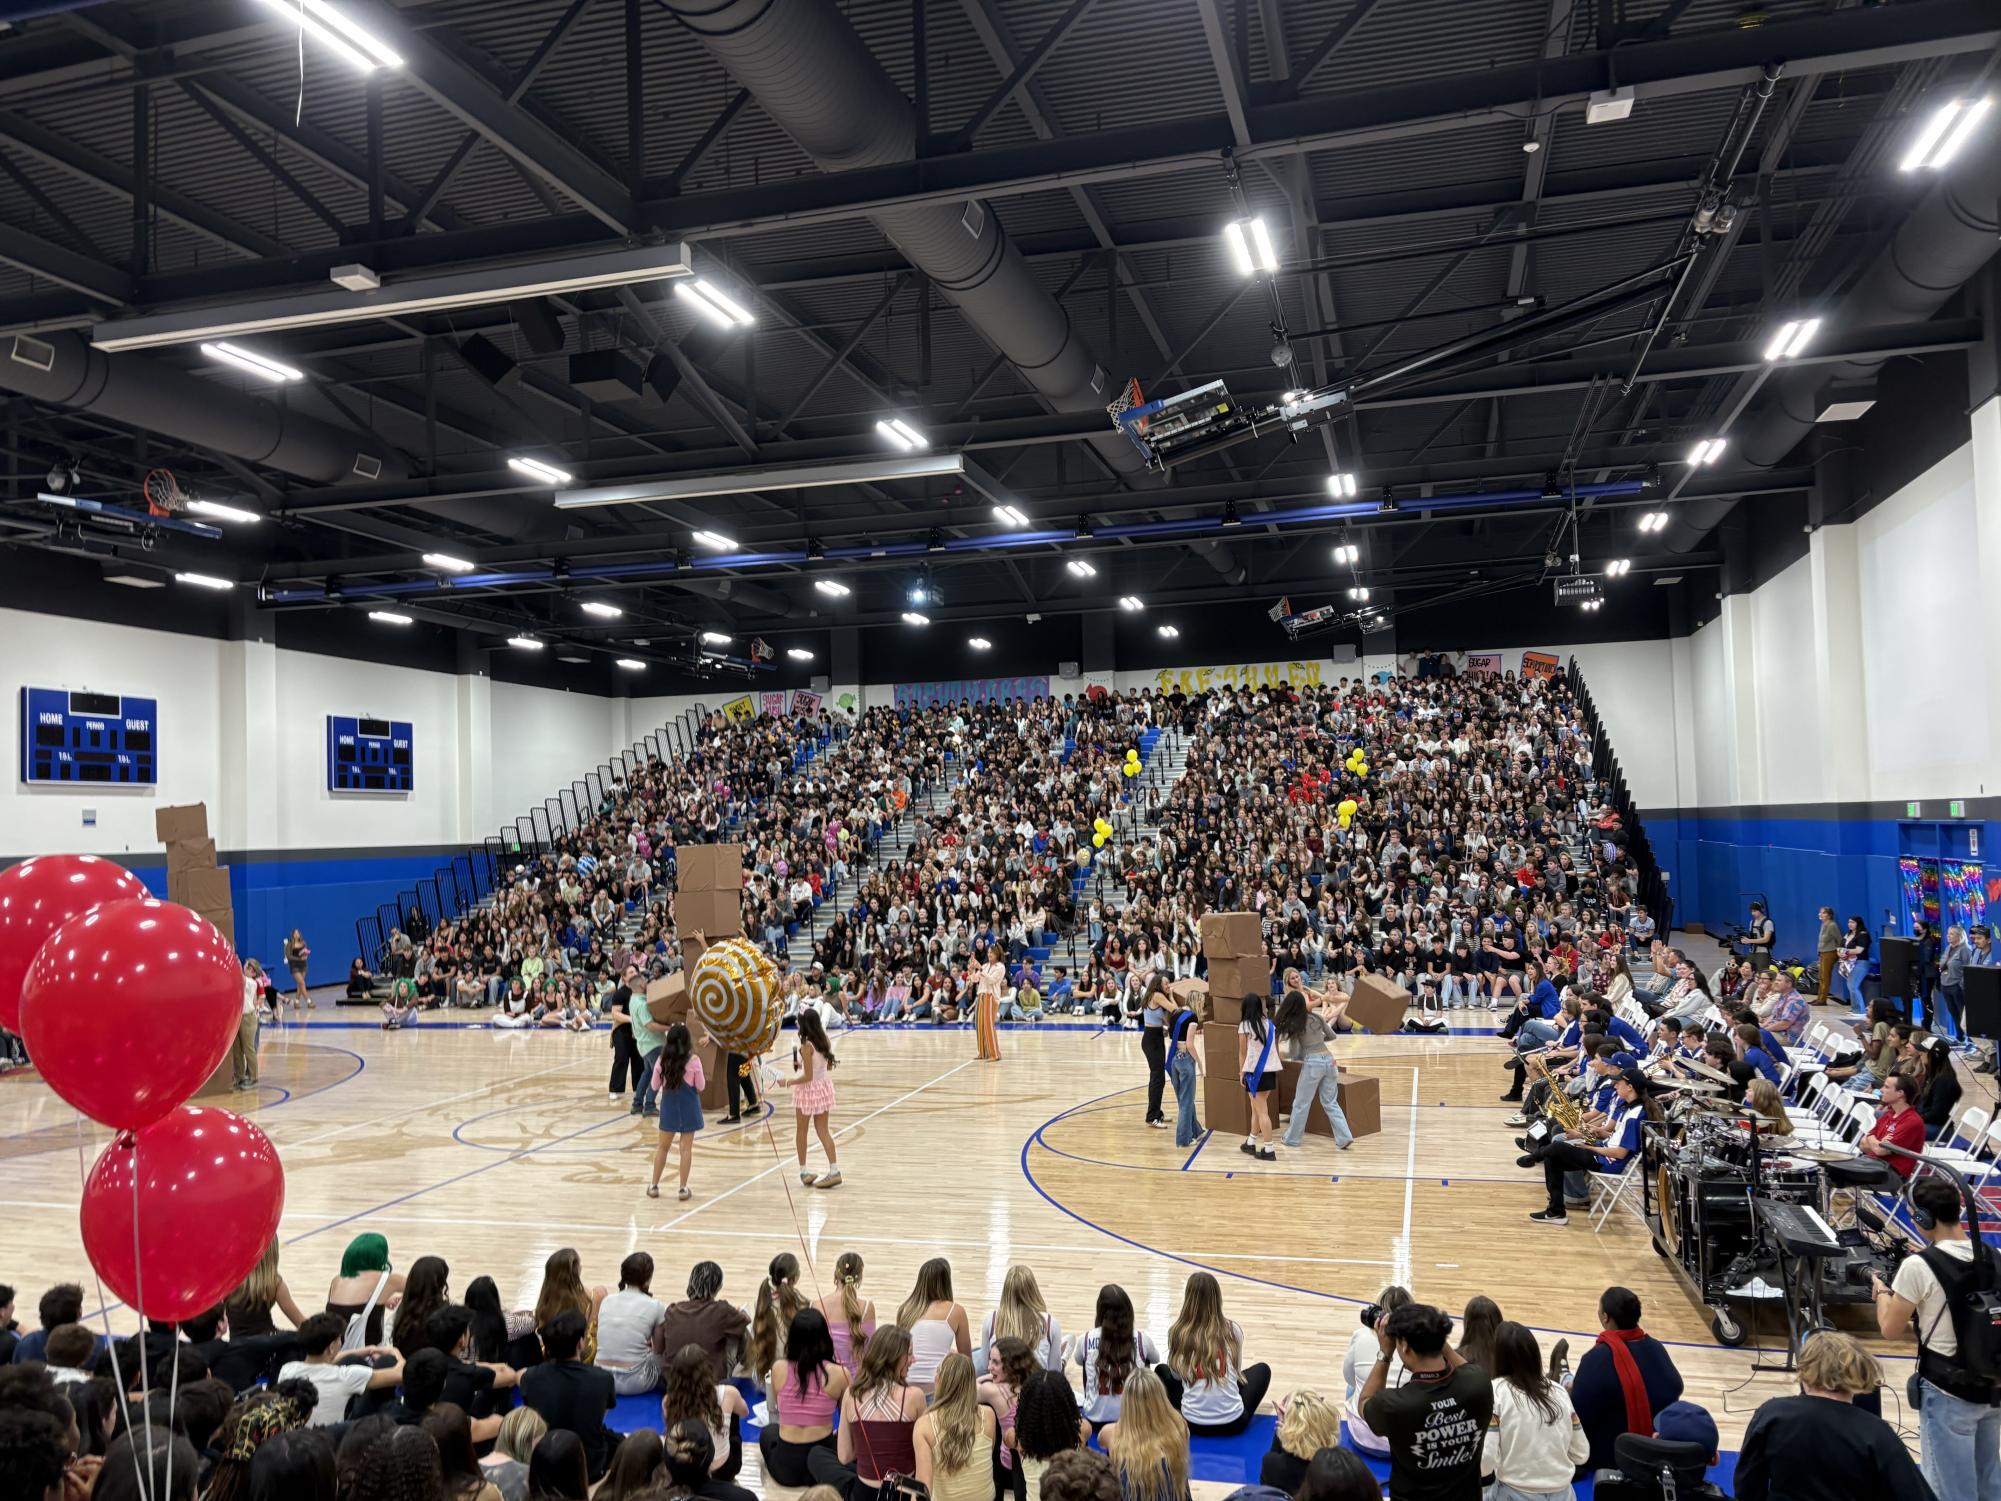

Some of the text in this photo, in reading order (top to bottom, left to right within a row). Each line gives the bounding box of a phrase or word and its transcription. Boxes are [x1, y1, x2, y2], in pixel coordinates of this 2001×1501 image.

[1468, 657, 1491, 668] SUGAR
[40, 713, 63, 725] HOME
[126, 719, 149, 731] GUEST
[86, 721, 105, 731] PERIOD
[340, 735, 354, 745] HOME
[394, 739, 408, 749] GUEST
[1430, 1397, 1457, 1410] YOUR
[1424, 1408, 1468, 1429] Best
[1414, 1418, 1479, 1444] POWER
[1426, 1434, 1471, 1450] IS YOUR
[1417, 1443, 1478, 1469] Smile!
